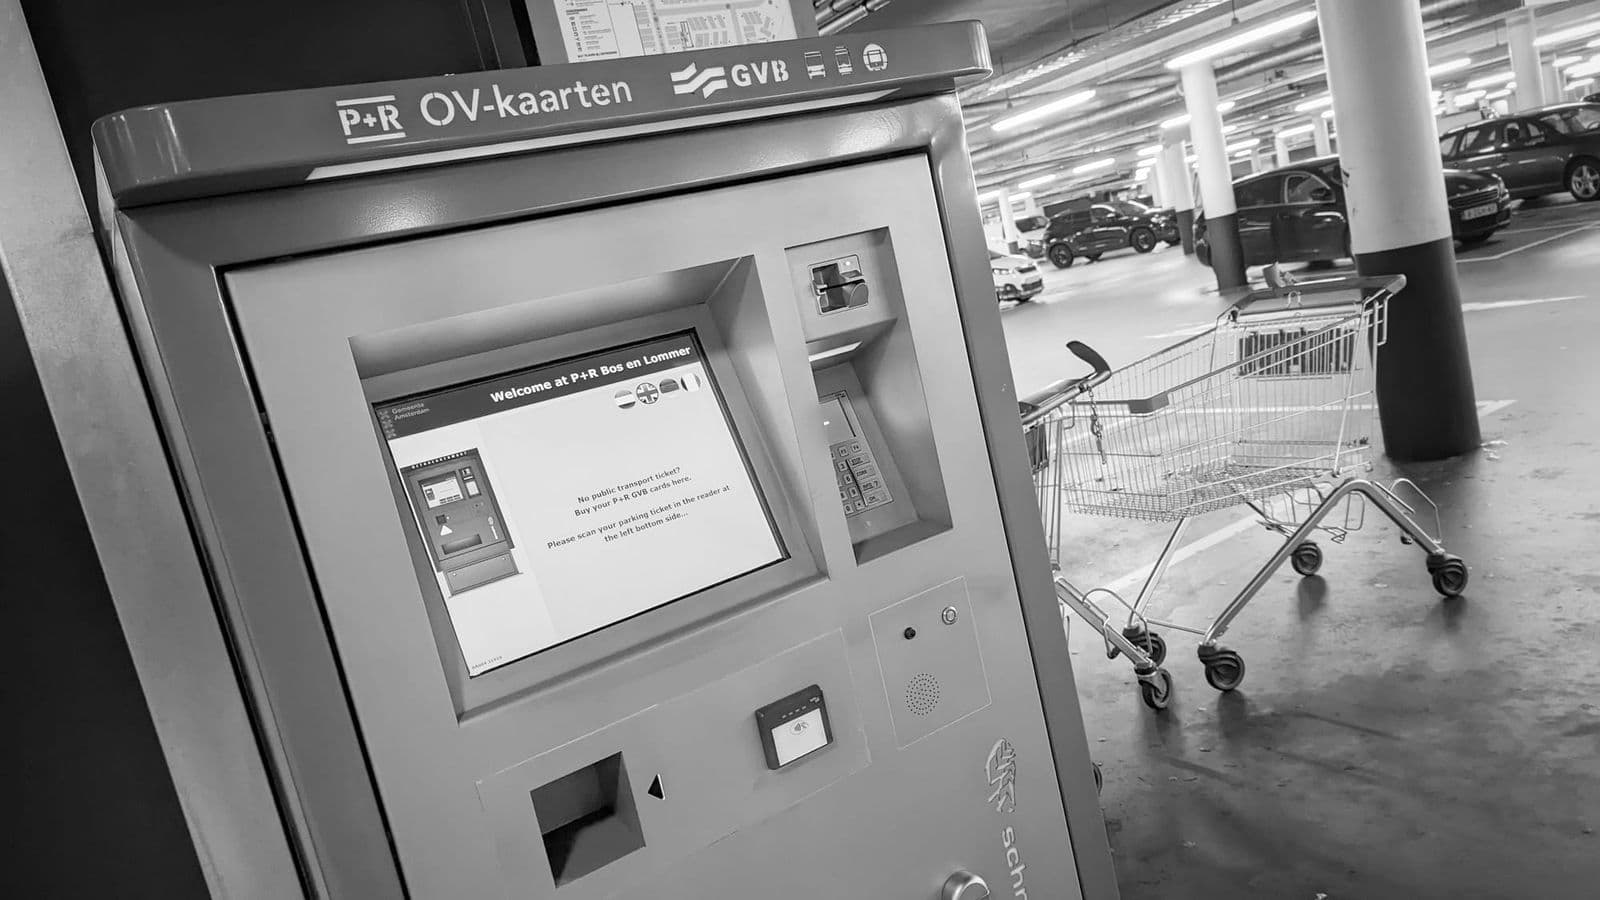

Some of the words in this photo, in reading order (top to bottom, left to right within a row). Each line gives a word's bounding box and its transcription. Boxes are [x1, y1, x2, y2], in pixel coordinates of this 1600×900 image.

[731, 60, 790, 88] GVB
[338, 105, 403, 136] P+R
[420, 80, 633, 127] OV-kaarten
[490, 378, 553, 403] Welcome
[554, 375, 570, 388] at
[570, 369, 600, 384] P+R
[600, 362, 624, 376] Bos
[625, 358, 643, 370] en
[643, 346, 692, 366] Lommer
[574, 506, 591, 517] Buy
[592, 501, 611, 513] your
[612, 493, 630, 505] P+R
[631, 488, 648, 500] GVB
[649, 481, 671, 493] cards
[672, 475, 692, 487] here.
[577, 495, 587, 504] No
[591, 487, 616, 503] public
[617, 475, 654, 493] transport
[654, 466, 681, 480] ticket?
[547, 534, 576, 550] Please
[577, 528, 597, 541] scan
[597, 521, 617, 535] your
[618, 511, 649, 528] parking
[650, 503, 673, 517] ticket
[673, 499, 682, 510] in
[682, 497, 695, 506] the
[696, 487, 720, 501] reader
[720, 484, 730, 494] at
[604, 534, 618, 543] the
[619, 527, 634, 538] left
[635, 518, 664, 532] bottom
[665, 510, 689, 523] side...
